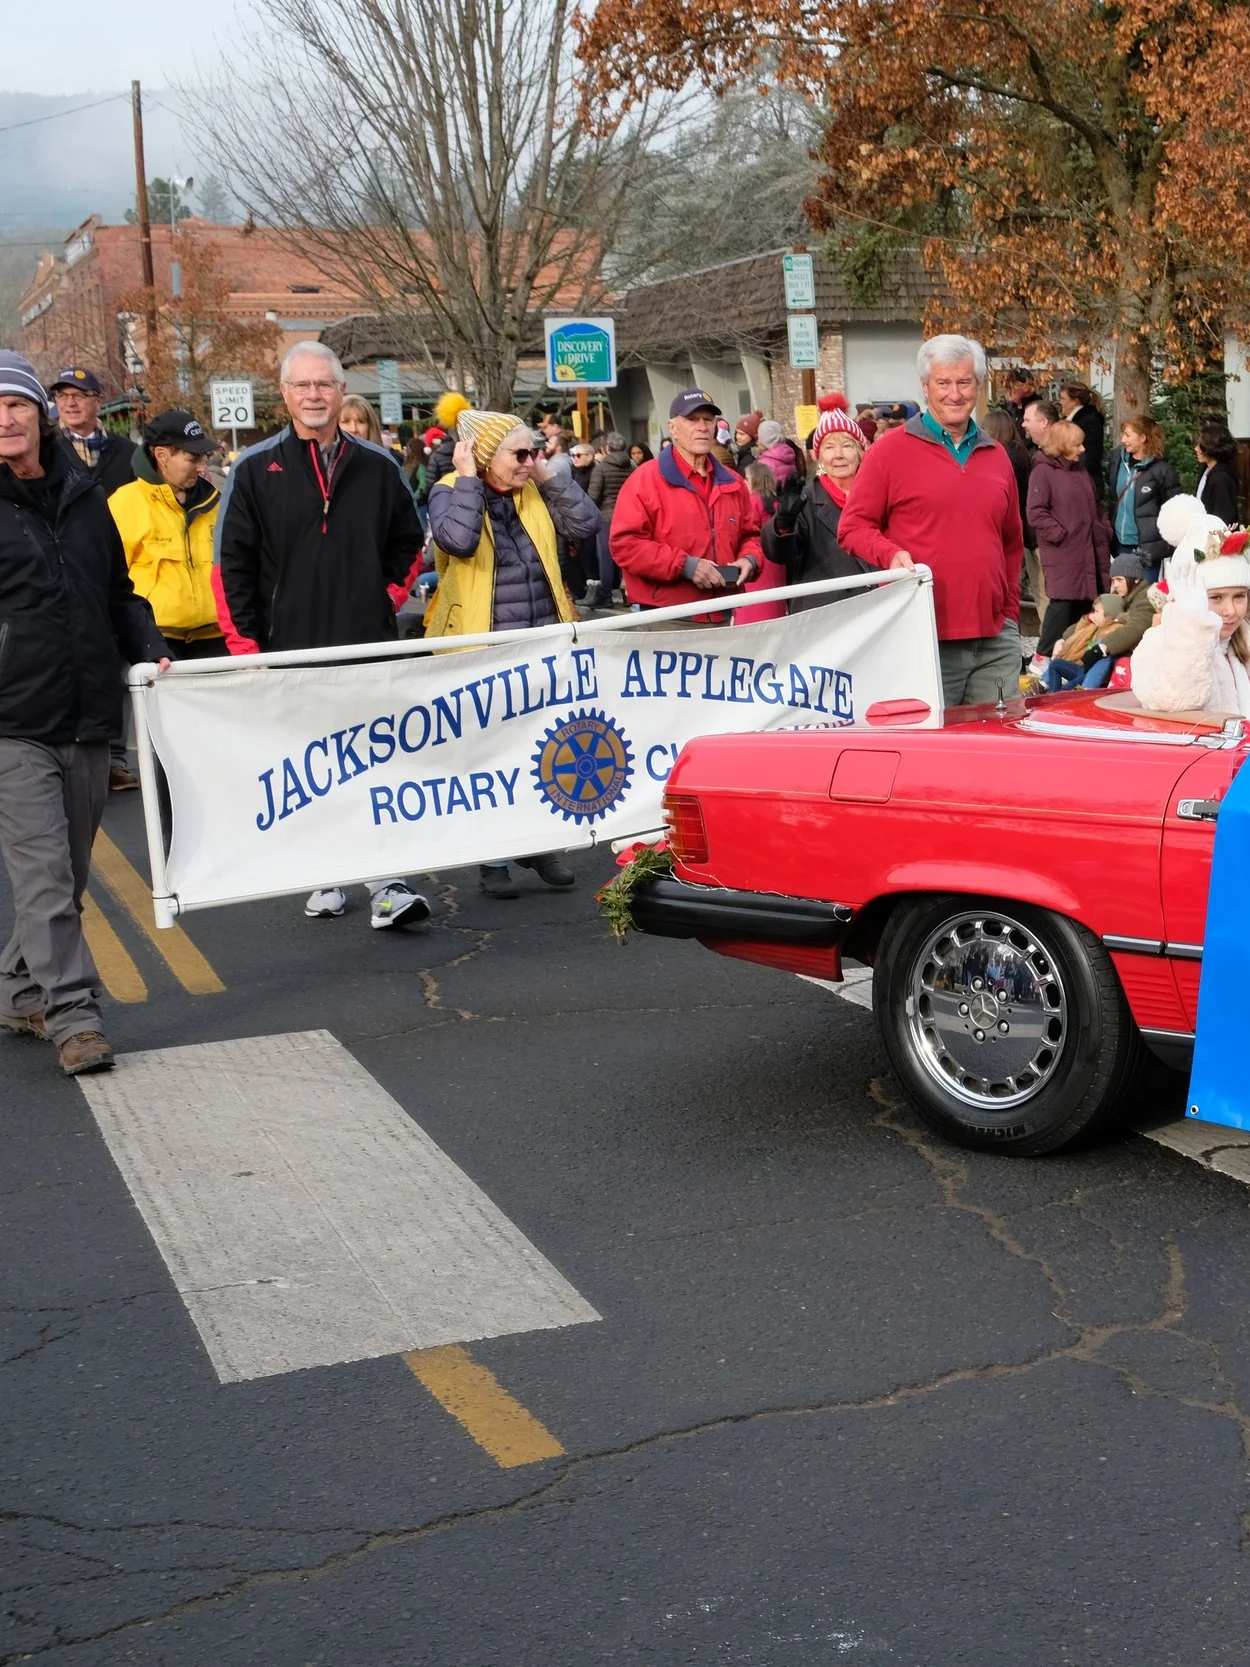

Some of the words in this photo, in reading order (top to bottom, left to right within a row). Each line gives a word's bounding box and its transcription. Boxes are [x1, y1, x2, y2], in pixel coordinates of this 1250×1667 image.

[557, 340, 603, 352] DISCOVERY
[568, 352, 596, 363] DRIVE
[215, 386, 248, 395] SPEED
[219, 396, 244, 404] LIMIT
[218, 406, 248, 422] 20
[561, 720, 601, 738] ROTARY
[256, 648, 599, 831] JACKSONVILLE
[620, 650, 854, 720] APPLEGATE
[369, 768, 521, 826] ROTARY
[550, 775, 623, 813] INTERNATIONAL
